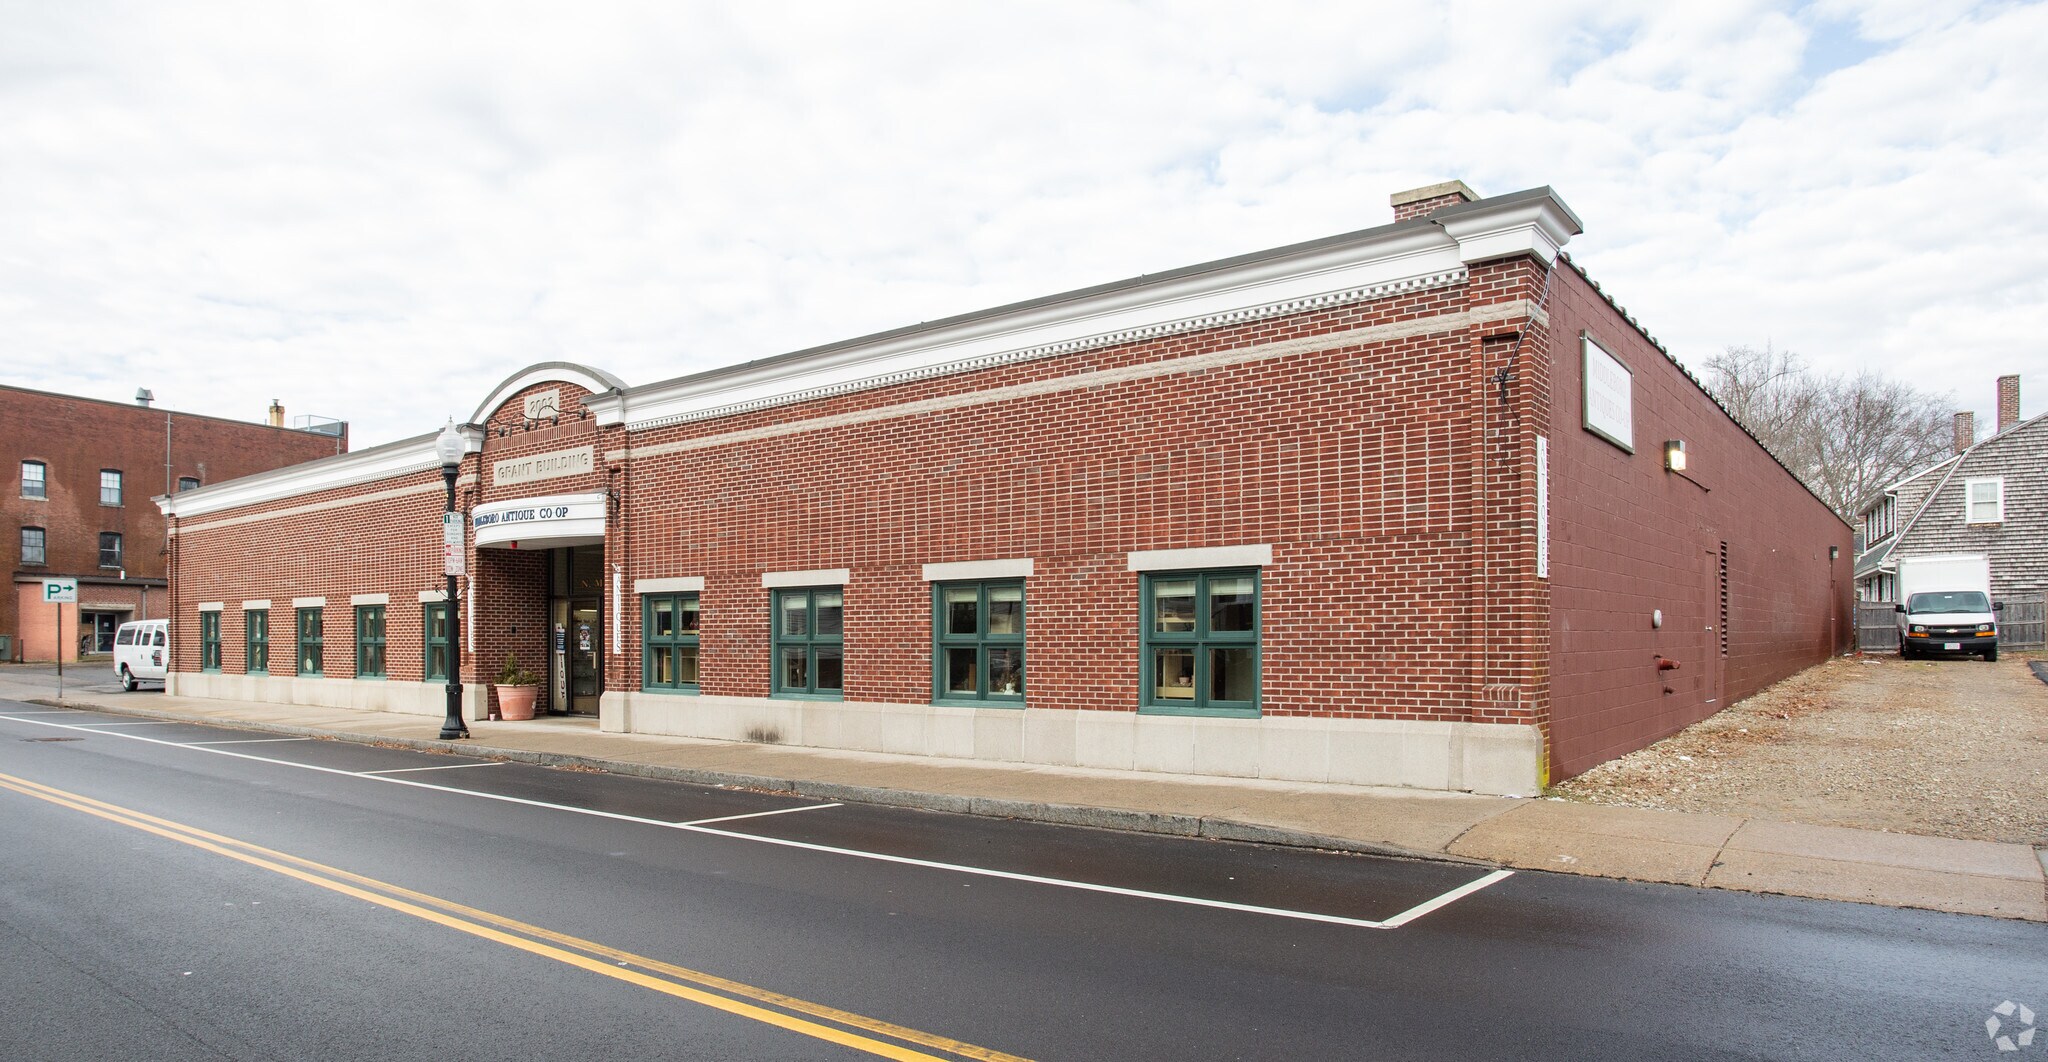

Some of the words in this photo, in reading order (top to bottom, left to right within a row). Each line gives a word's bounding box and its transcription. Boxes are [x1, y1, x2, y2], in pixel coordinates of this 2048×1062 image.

[498, 461, 532, 479] GRANT
[536, 453, 588, 474] BUILDING
[501, 509, 535, 523] ANTIQUE
